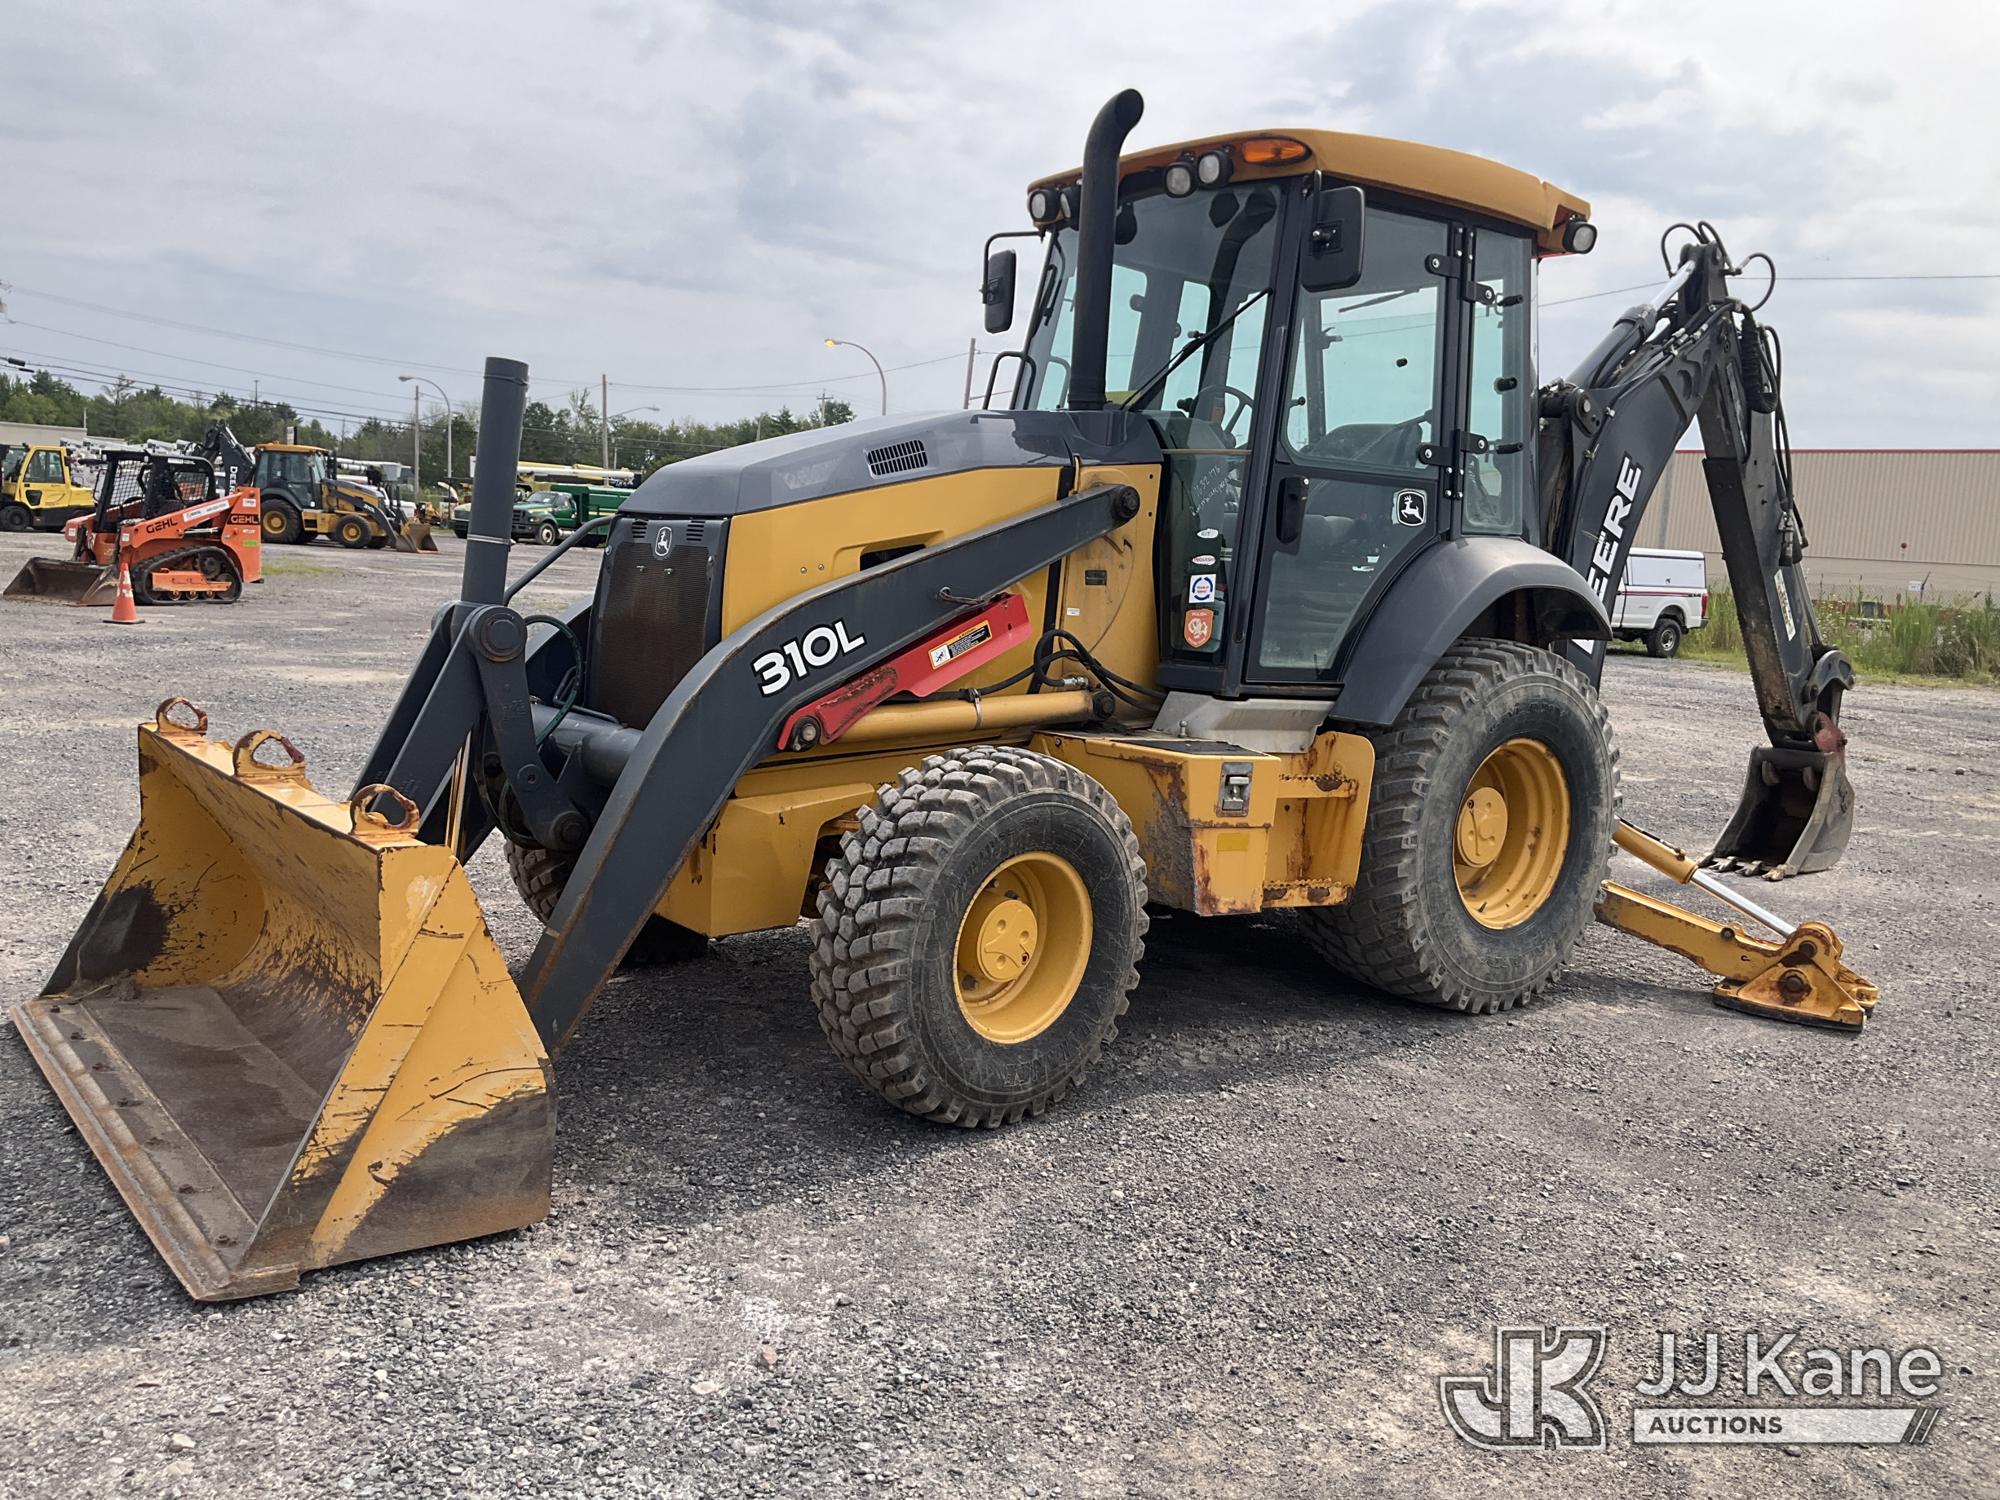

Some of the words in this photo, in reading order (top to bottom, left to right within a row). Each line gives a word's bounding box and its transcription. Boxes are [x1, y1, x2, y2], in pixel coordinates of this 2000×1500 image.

[145, 518, 178, 534] GEHL
[230, 515, 259, 525] GEHL
[1571, 456, 1642, 655] EERE
[752, 620, 865, 695] 310L
